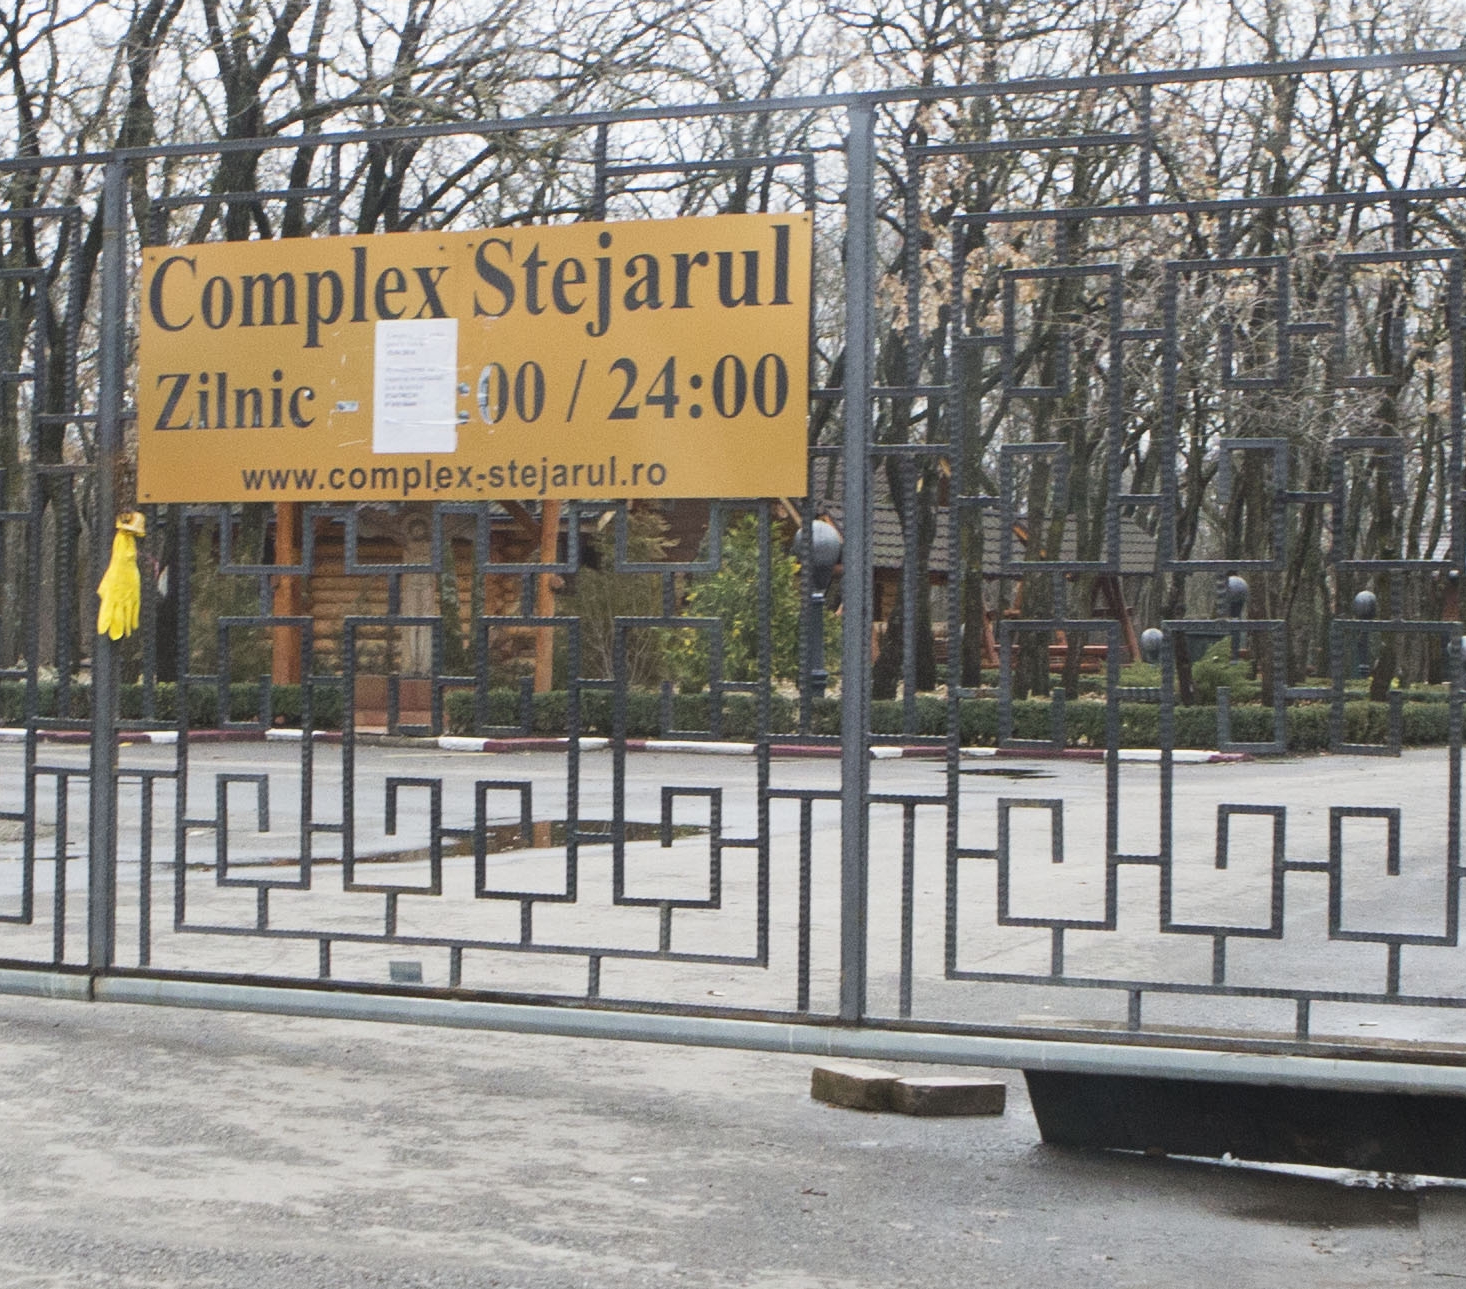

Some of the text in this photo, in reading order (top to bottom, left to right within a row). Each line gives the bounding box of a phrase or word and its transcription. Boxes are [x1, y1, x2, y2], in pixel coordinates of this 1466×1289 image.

[149, 224, 793, 349] Complex Stejarul
[153, 368, 316, 432] Zilnic
[606, 352, 790, 421] 24:00
[241, 456, 667, 497] www.complex-stejarul.ro
